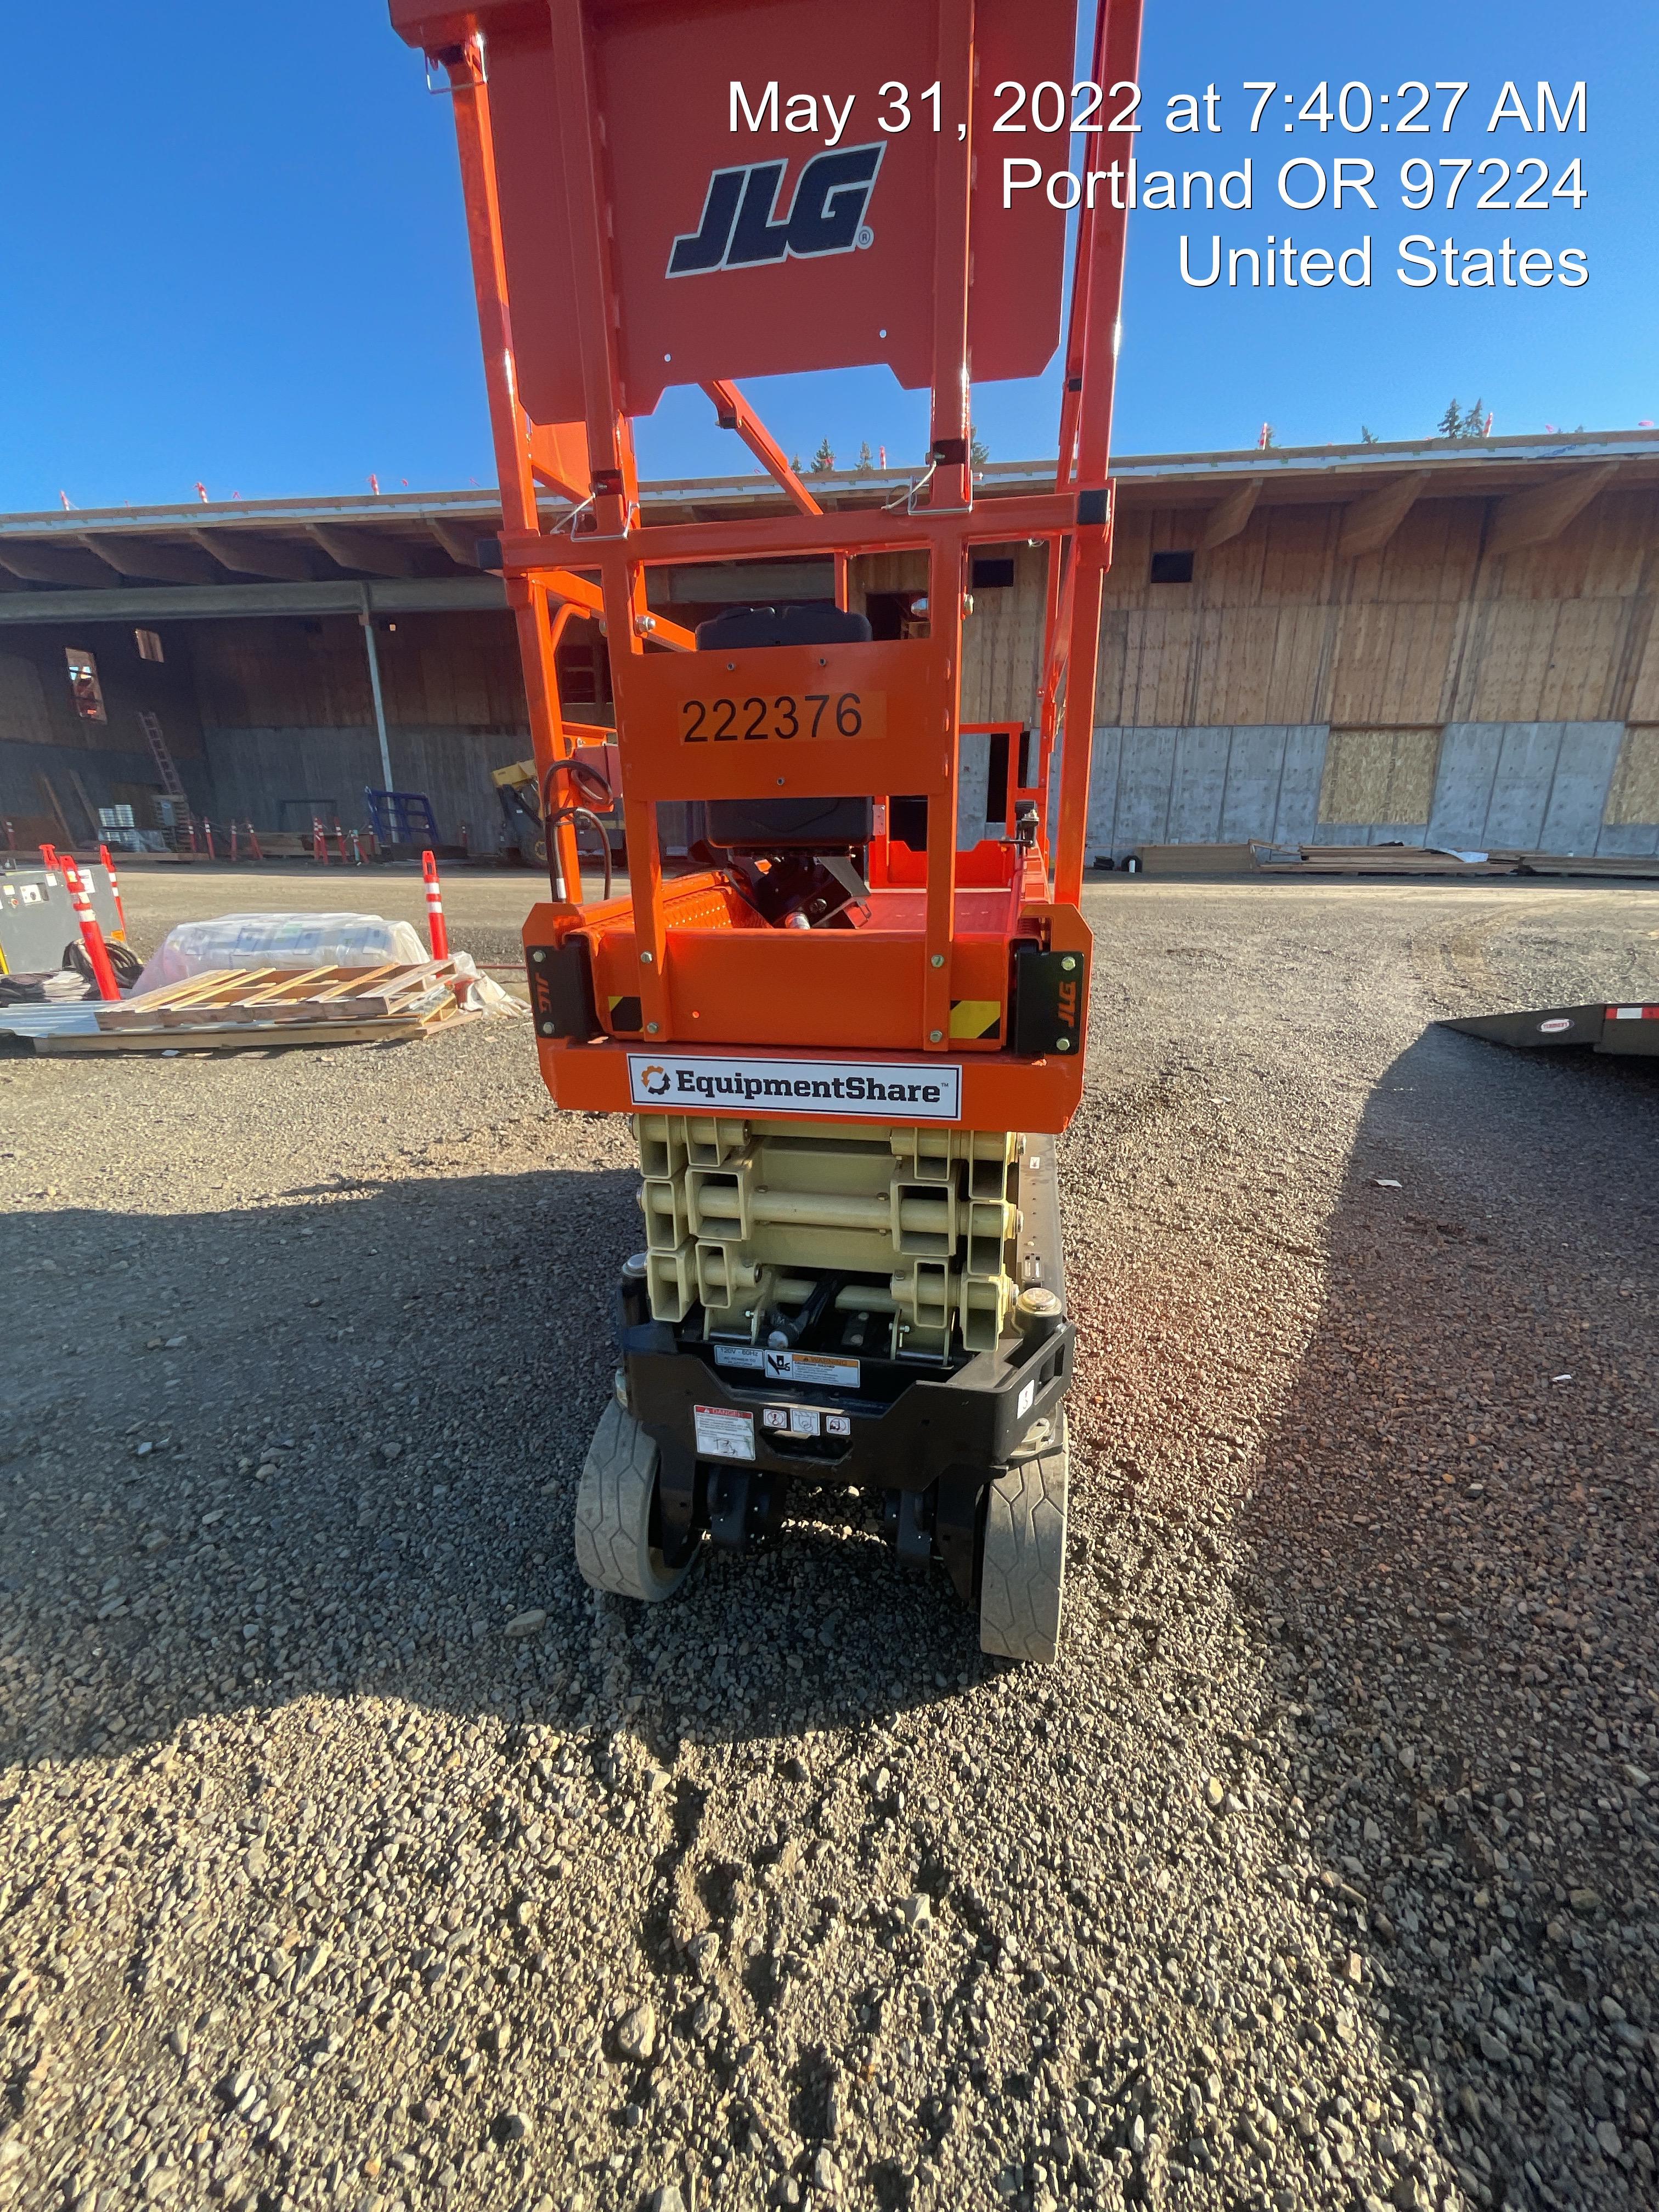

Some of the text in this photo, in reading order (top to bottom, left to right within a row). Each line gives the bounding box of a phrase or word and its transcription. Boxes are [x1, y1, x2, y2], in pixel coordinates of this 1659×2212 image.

[665, 140, 887, 279] JLG
[682, 692, 862, 743] 222376
[535, 972, 553, 1014] JLG
[1057, 981, 1077, 1028] JLG
[675, 1070, 941, 1103] EquipmentShare
[811, 1357, 847, 1365] WARNING
[713, 1408, 743, 1418] DANGER
